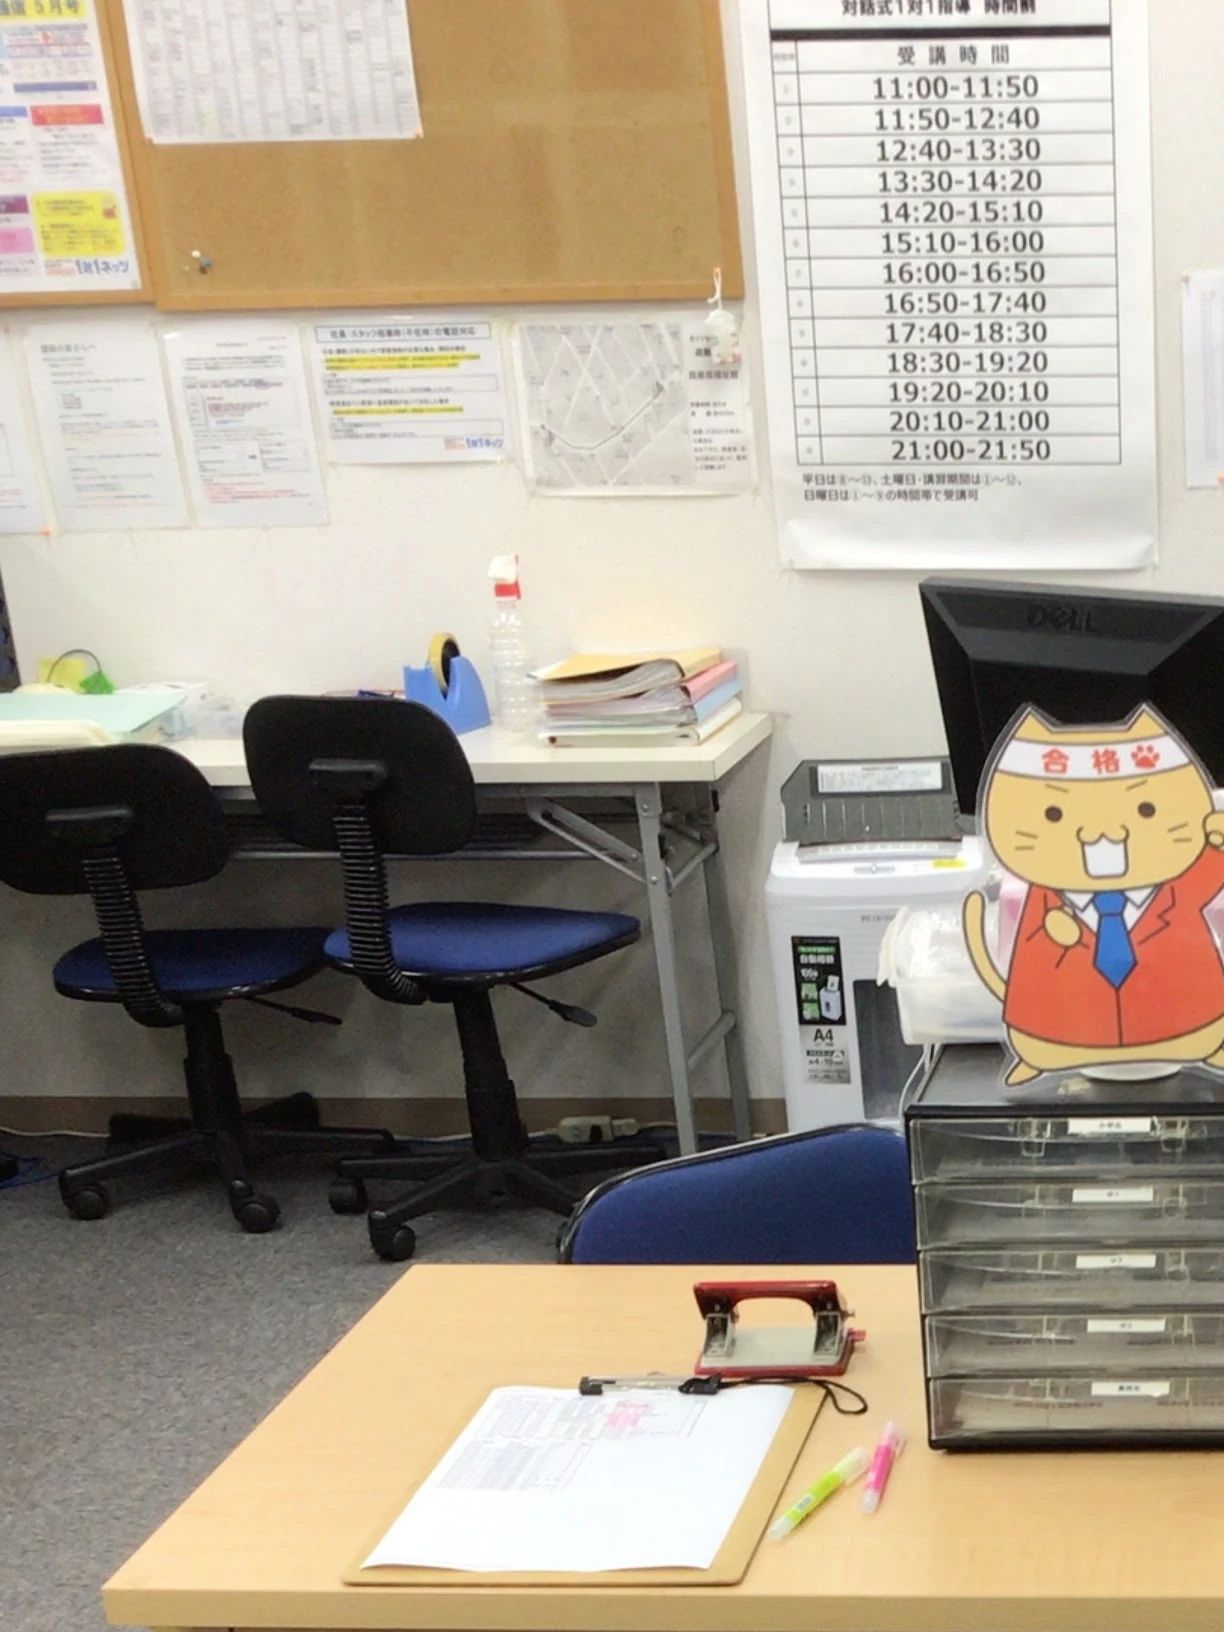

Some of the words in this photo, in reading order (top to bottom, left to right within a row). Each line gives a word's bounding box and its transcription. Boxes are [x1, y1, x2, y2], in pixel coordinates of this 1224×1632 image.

[897, 45, 1010, 65] 受講時間
[874, 76, 1038, 99] 11:00-11:50
[875, 107, 1039, 130] 11:50-12:40
[877, 139, 1040, 161] 12:40-13:30
[879, 170, 1041, 192] 13:30-14:20
[881, 201, 1042, 223] 14:20-15:10
[882, 231, 1043, 253] 15:10-16:00
[884, 262, 1045, 283] 16:00-16:50
[885, 292, 1046, 313] 16:50-17:40
[887, 322, 1046, 343] 17:40-18:30
[888, 352, 1047, 373] 18:30-19:20
[889, 381, 1048, 402] 19:20-20:10
[890, 411, 1049, 431] 20:10-21:00
[892, 440, 1050, 460] 21:00-21:50
[1041, 747, 1120, 774] 合格
[813, 1028, 834, 1042] A4
